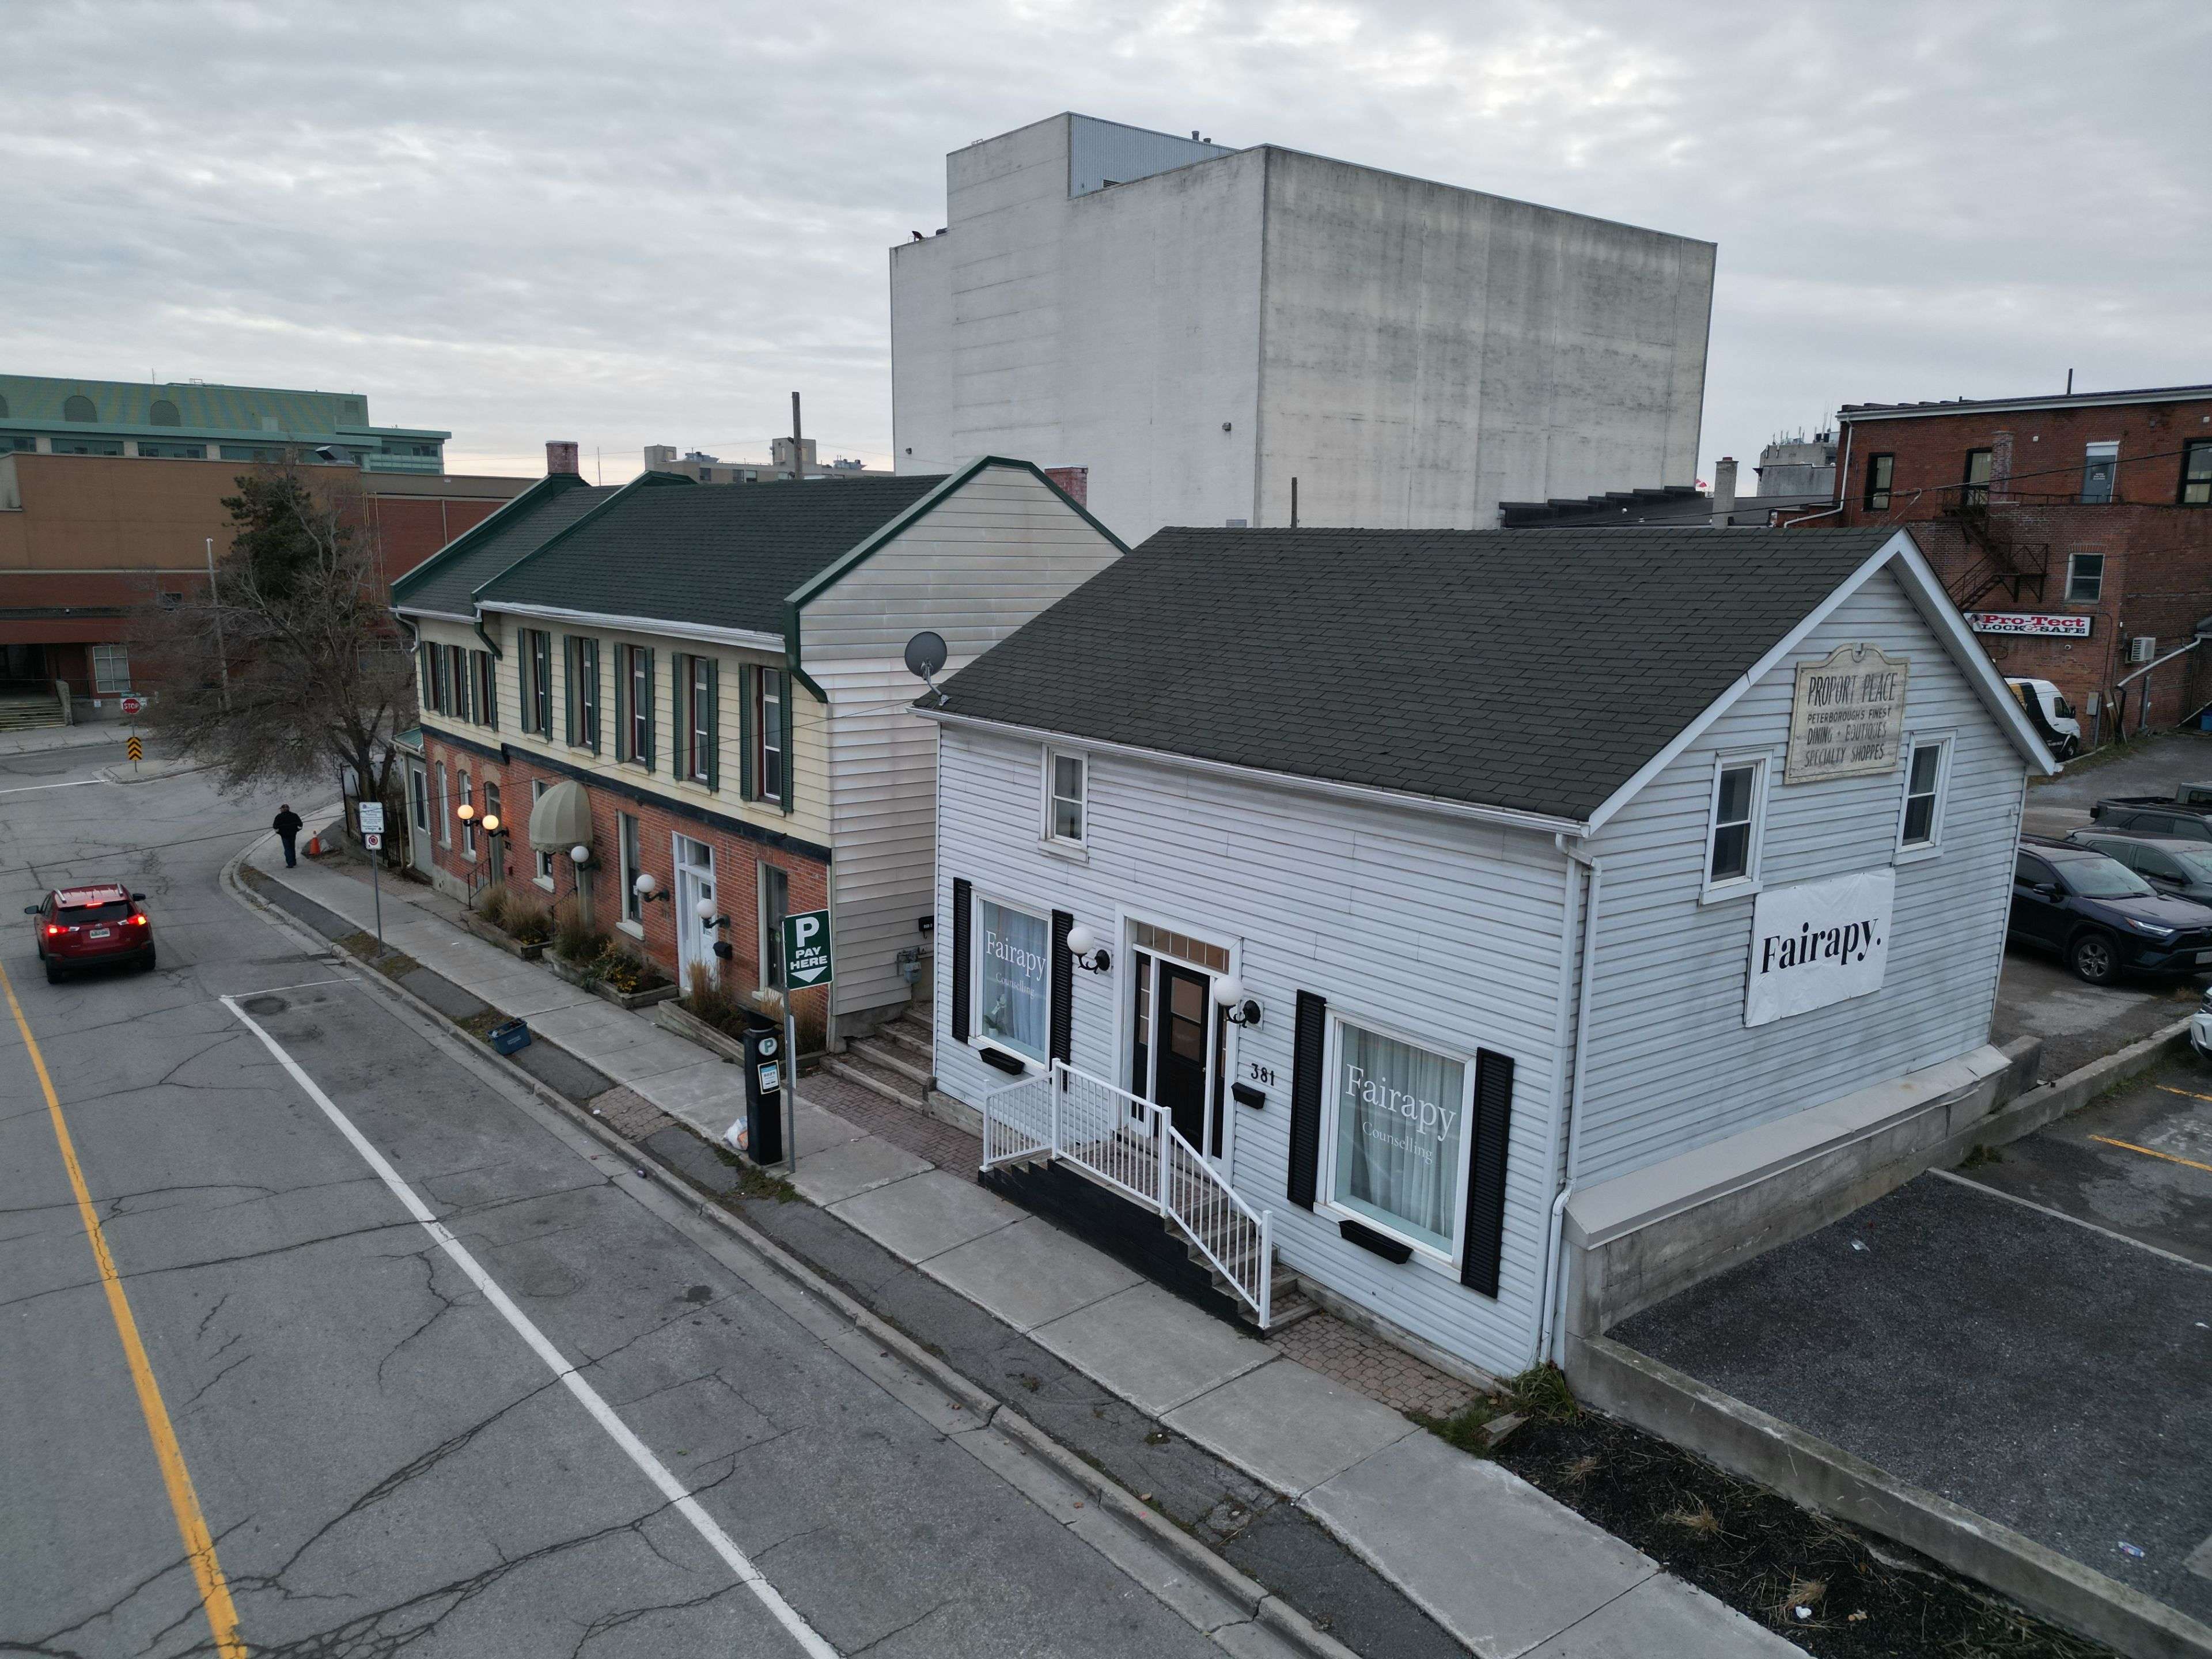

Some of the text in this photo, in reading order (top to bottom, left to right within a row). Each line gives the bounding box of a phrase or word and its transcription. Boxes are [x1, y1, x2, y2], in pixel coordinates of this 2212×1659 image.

[1982, 615, 2085, 627] Pro-Tect
[2040, 626, 2085, 634] SAFE
[1808, 672, 1898, 707] PROPORT PLACE
[1868, 707, 1891, 719] FINEST
[1806, 721, 1887, 745] DINING BOUTIQUES
[1804, 743, 1885, 767] SPECIALTY SHOPPES
[796, 916, 820, 948] P
[796, 946, 822, 959] PAY
[986, 930, 1046, 982] Fairapy
[1760, 918, 1881, 974] Fairapy.
[790, 955, 828, 971] HERE
[996, 972, 1035, 999] Counselling
[764, 1039, 774, 1054] P
[1251, 1063, 1274, 1086] 381
[1345, 1063, 1456, 1142] Fairapy
[1362, 1121, 1433, 1165] Counselling
